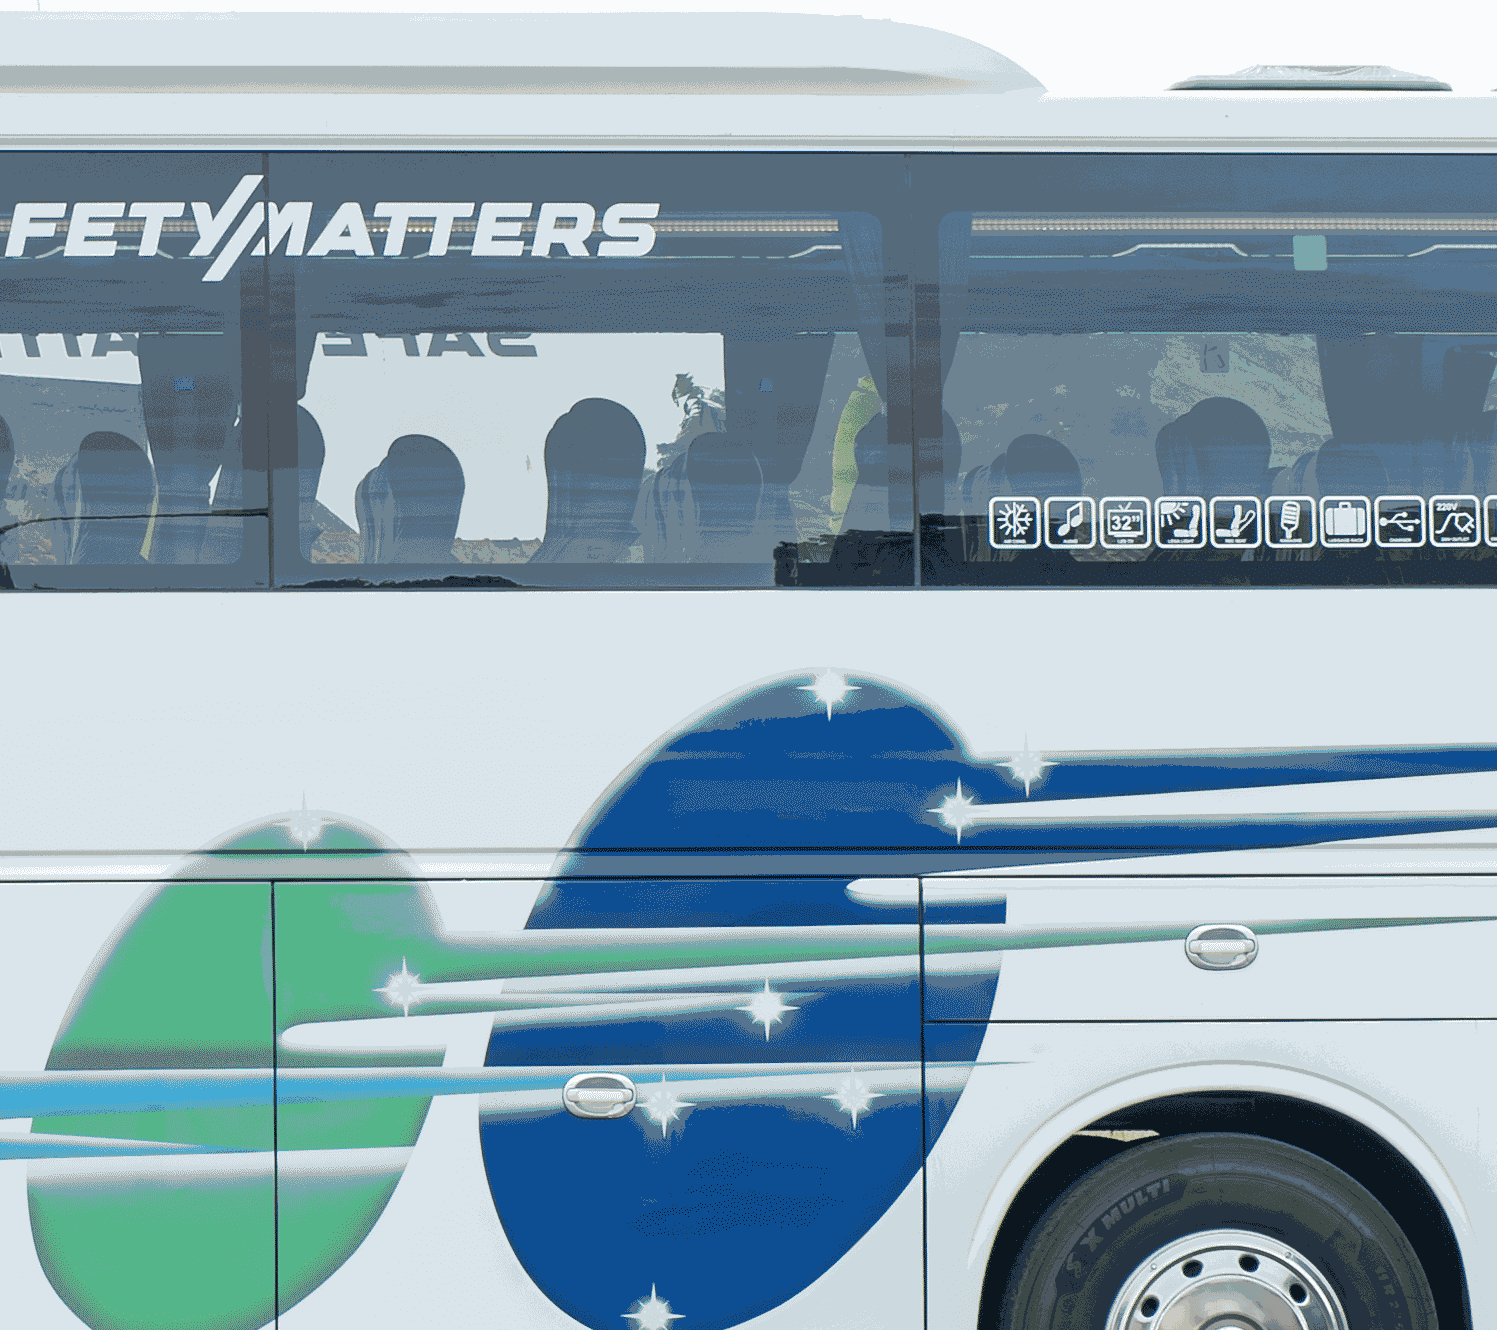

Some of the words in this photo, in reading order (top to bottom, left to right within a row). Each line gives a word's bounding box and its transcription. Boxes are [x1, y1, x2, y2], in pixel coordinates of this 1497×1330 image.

[246, 202, 661, 258] MATTERS
[1435, 502, 1459, 512] 220V
[1101, 1178, 1170, 1231] MULTI
